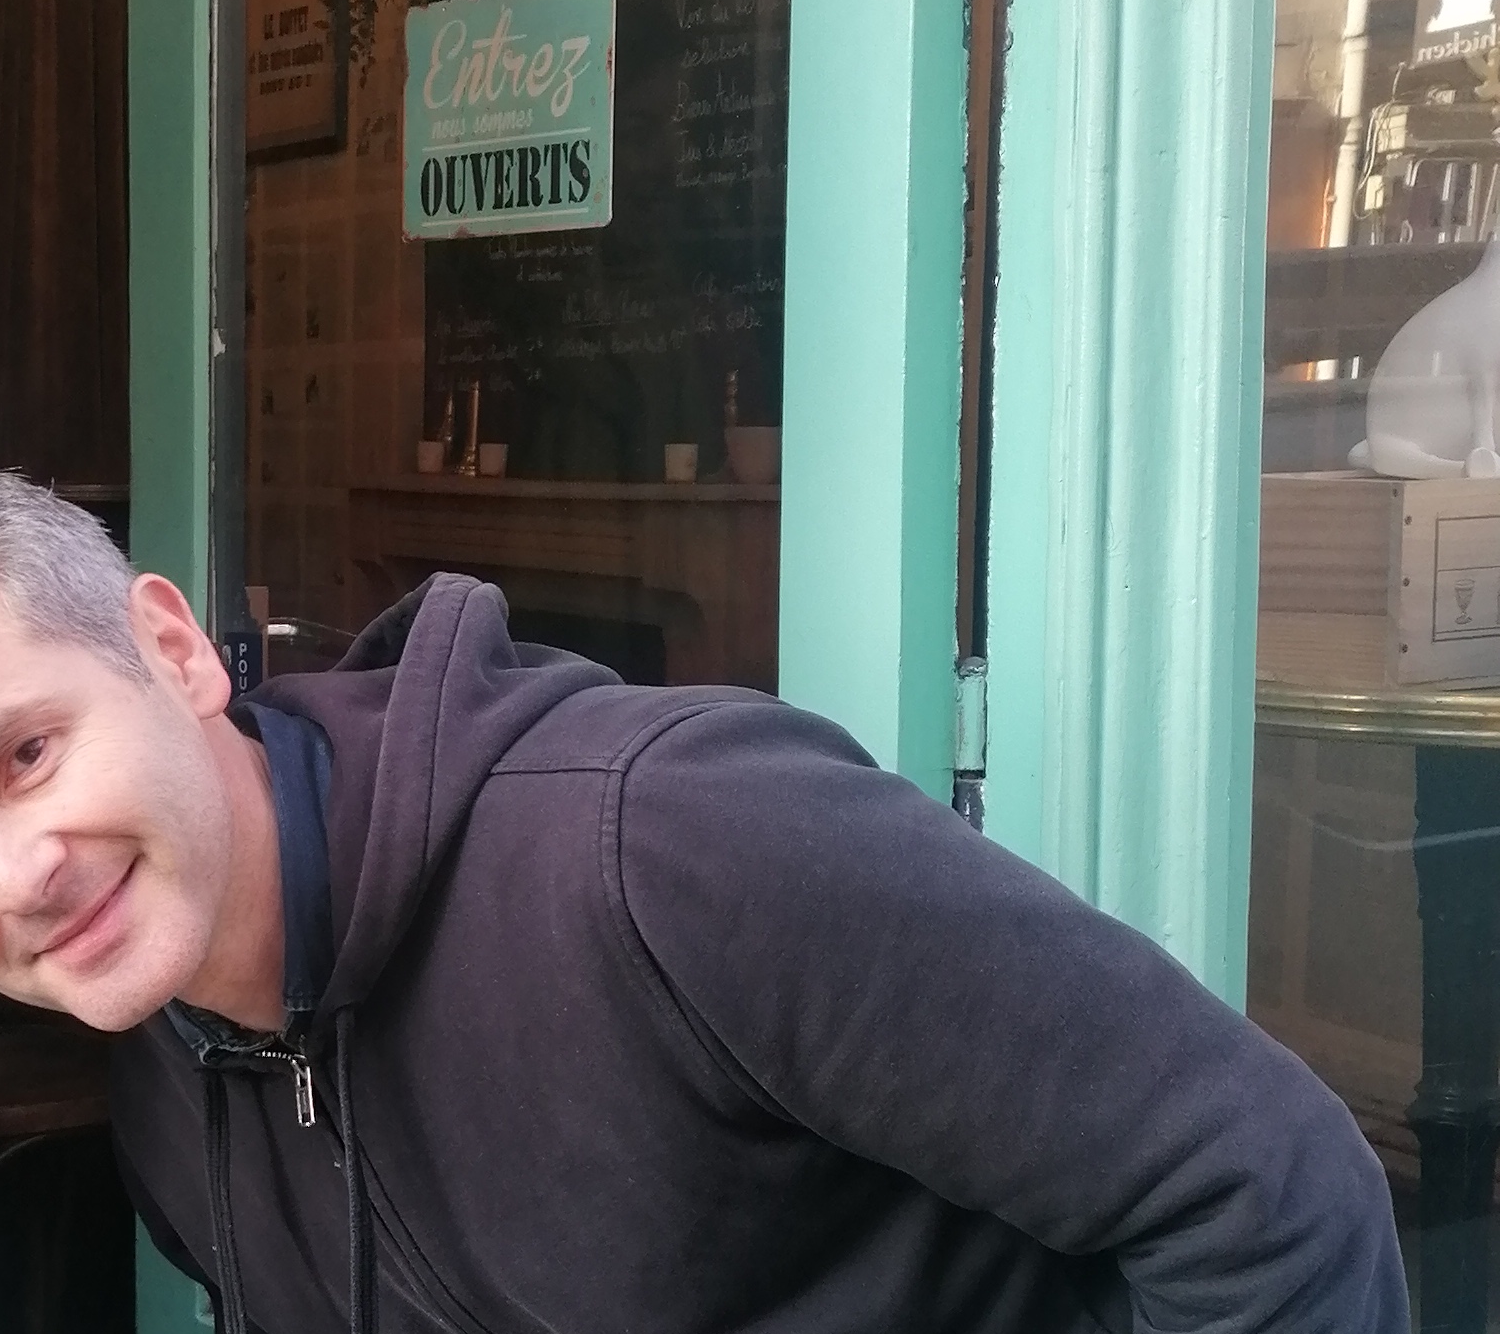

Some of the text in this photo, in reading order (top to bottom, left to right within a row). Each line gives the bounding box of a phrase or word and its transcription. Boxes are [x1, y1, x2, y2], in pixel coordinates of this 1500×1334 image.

[423, 5, 591, 117] Entrez
[420, 139, 592, 217] OUVERTS
[238, 641, 249, 696] POU
